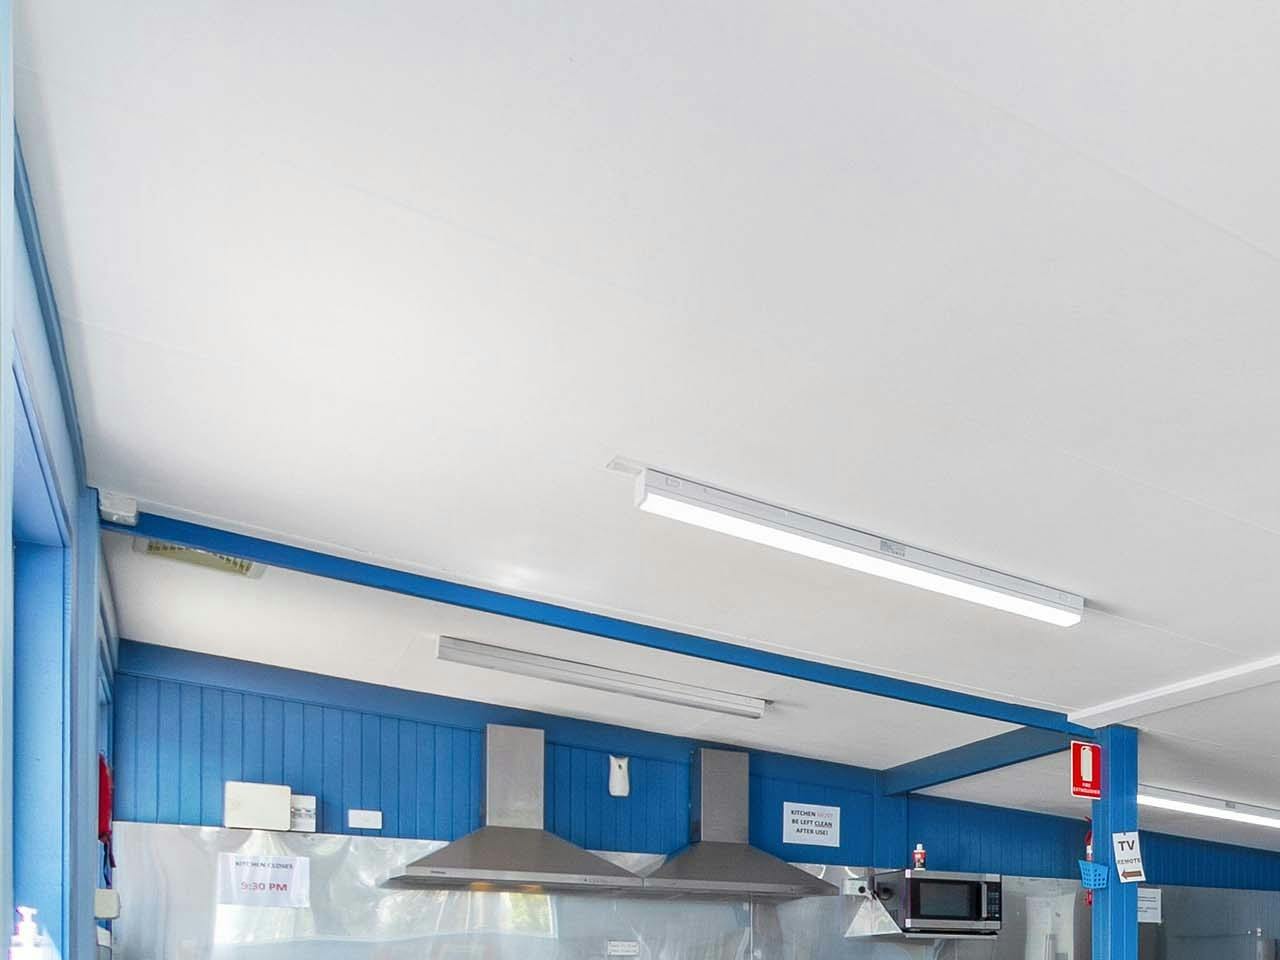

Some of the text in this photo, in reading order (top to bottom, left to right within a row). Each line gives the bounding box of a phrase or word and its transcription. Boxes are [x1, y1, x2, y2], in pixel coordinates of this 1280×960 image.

[1118, 840, 1135, 851] TV
[241, 881, 288, 891] 9:30 PM
